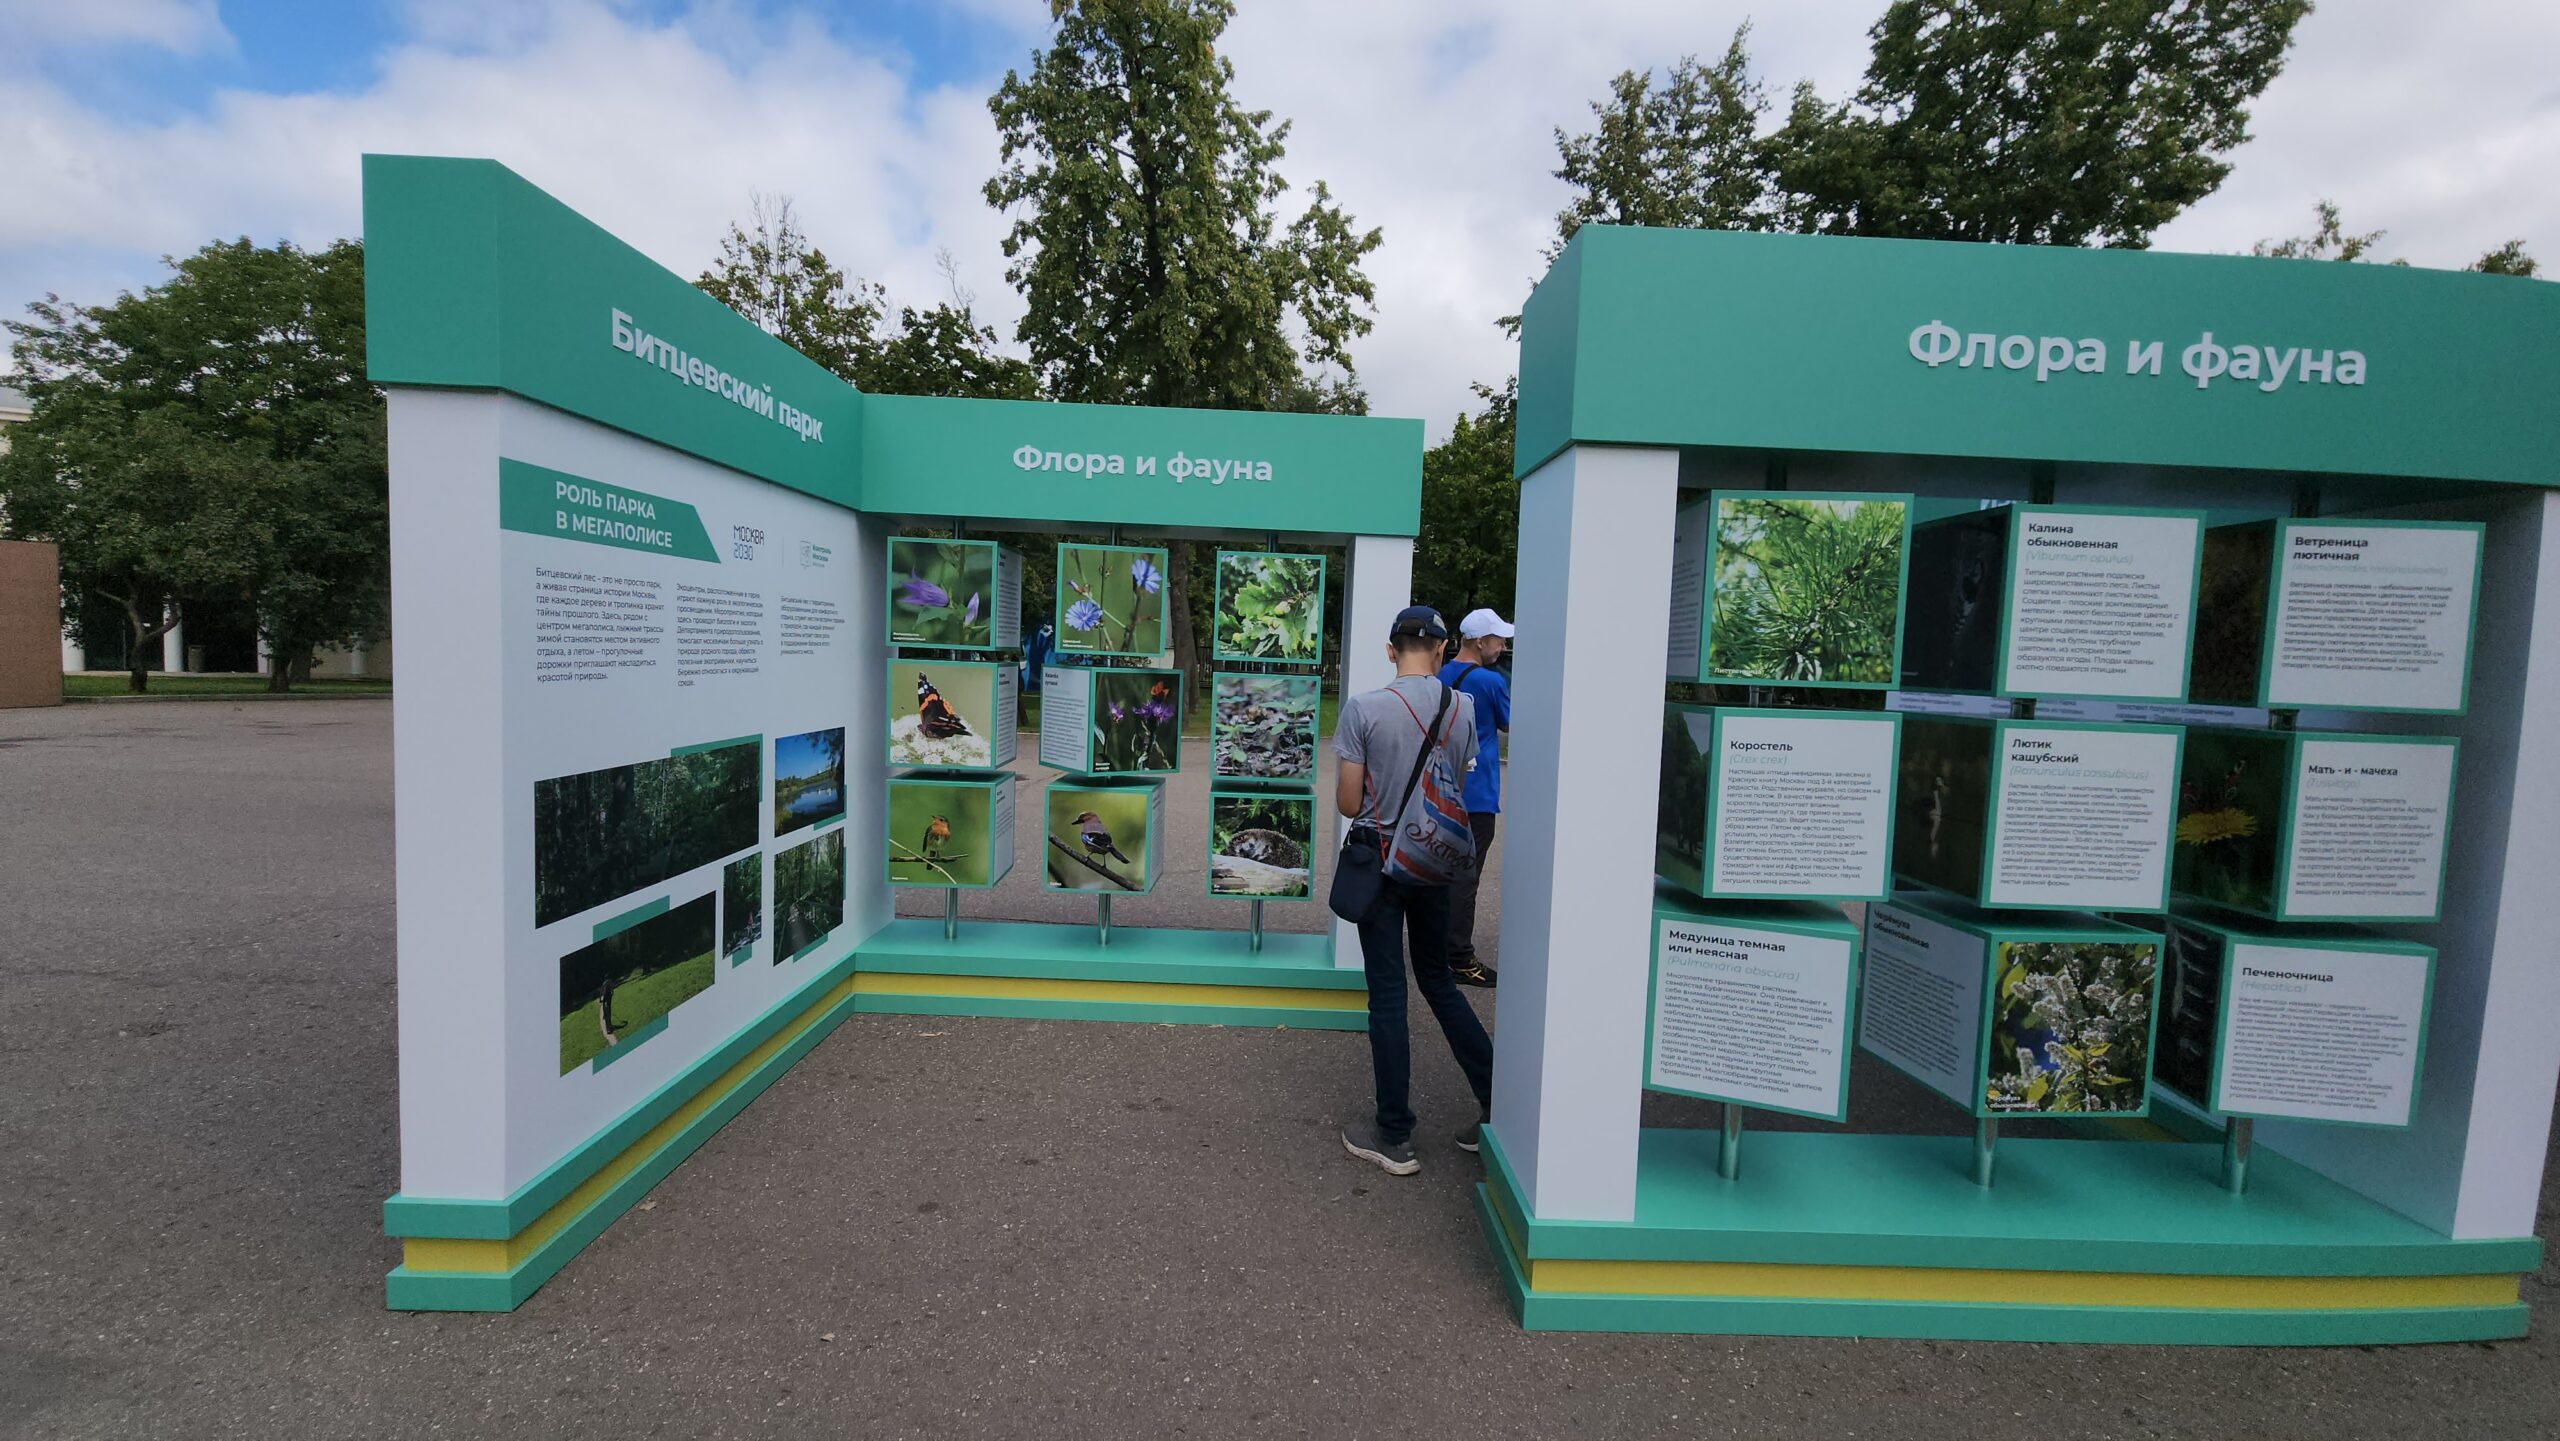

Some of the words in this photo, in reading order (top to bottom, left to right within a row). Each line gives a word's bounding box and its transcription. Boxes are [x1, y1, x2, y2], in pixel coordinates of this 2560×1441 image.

[1908, 318, 2107, 382] Флора
[2125, 339, 2164, 375] и
[2181, 331, 2367, 392] фауна
[612, 307, 774, 420] Битцевский
[779, 401, 823, 443] парк
[1012, 444, 1125, 480] Флора
[1136, 455, 1157, 476] и
[1167, 451, 1273, 485] фауна
[556, 480, 603, 509] РОЛЬ
[606, 493, 656, 521] ПАРКА
[556, 511, 568, 530] В
[572, 512, 673, 549] МЕГАПОЛИСЕ
[733, 524, 765, 546] МОСКВА
[2028, 523, 2074, 534] Калина
[2027, 538, 2118, 549] обыкновенная
[2294, 537, 2369, 548] Ветреница
[733, 543, 754, 561] 2030
[2293, 551, 2360, 561] лютичная
[535, 567, 582, 580] Битцевский
[583, 574, 597, 582] лес
[601, 576, 613, 584] это
[623, 578, 646, 589] просто
[645, 581, 662, 590] парк,
[541, 583, 568, 592] живая
[568, 585, 602, 595] страница
[603, 588, 631, 598] истории
[631, 589, 657, 600] Москвы,
[535, 595, 550, 604] где
[551, 596, 580, 606] каждое
[580, 598, 607, 608] дерево
[612, 601, 644, 610] тропинка
[643, 603, 665, 611] хранит
[535, 607, 561, 617] тайны
[562, 610, 601, 620] прошлого.
[599, 610, 622, 621] Здесь,
[622, 613, 643, 622] рядом
[536, 622, 571, 632] центром
[571, 621, 615, 632] мегаполиса,
[642, 625, 664, 634] трассы
[535, 633, 562, 643] зимой
[562, 635, 603, 644] становятся
[604, 636, 628, 644] местом
[536, 648, 567, 657] отдыха,
[572, 648, 595, 656] летом
[600, 648, 644, 657] прогулочные
[536, 661, 572, 670] дорожки
[573, 660, 617, 670] приглашают
[616, 659, 656, 667] насладиться
[537, 671, 573, 684] красотой
[574, 672, 608, 682] природы.
[1730, 740, 1794, 752] Коростель
[2012, 739, 2052, 749] Лютик
[2011, 753, 2079, 764] кашубский
[2308, 765, 2335, 775] Мать
[2344, 767, 2352, 775] и
[2360, 767, 2398, 776] мачеха
[1669, 929, 1735, 946] Медуница
[1738, 939, 1786, 952] темная
[1668, 945, 1692, 954] или
[1695, 947, 1749, 961] неясная
[2242, 967, 2334, 983] Печеночница
